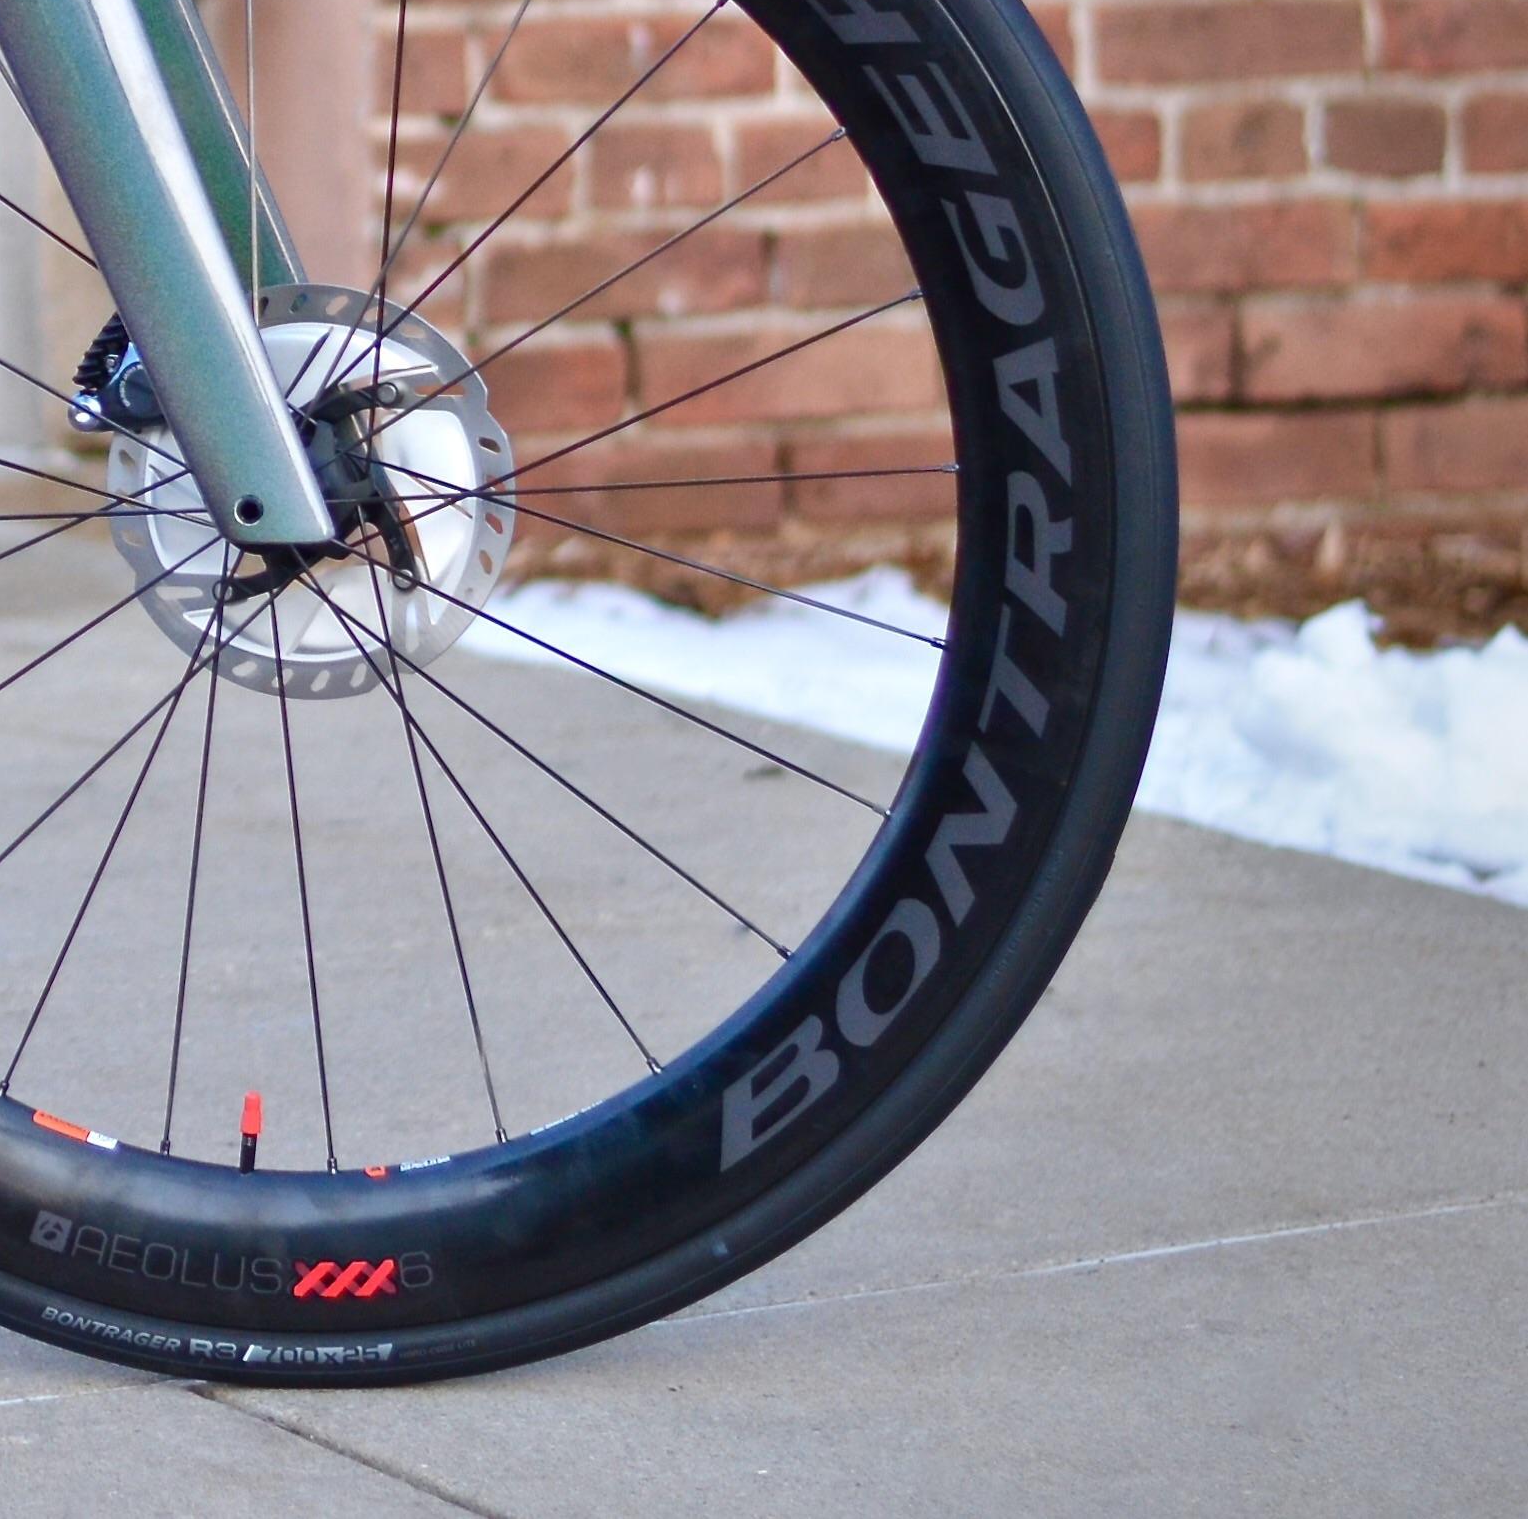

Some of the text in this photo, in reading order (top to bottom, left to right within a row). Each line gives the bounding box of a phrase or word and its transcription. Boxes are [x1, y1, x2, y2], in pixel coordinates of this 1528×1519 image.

[70, 1222, 285, 1295] AEOLUS
[398, 1250, 434, 1289] 6
[41, 1305, 181, 1353] BONTRAGER
[189, 1337, 238, 1361] R3
